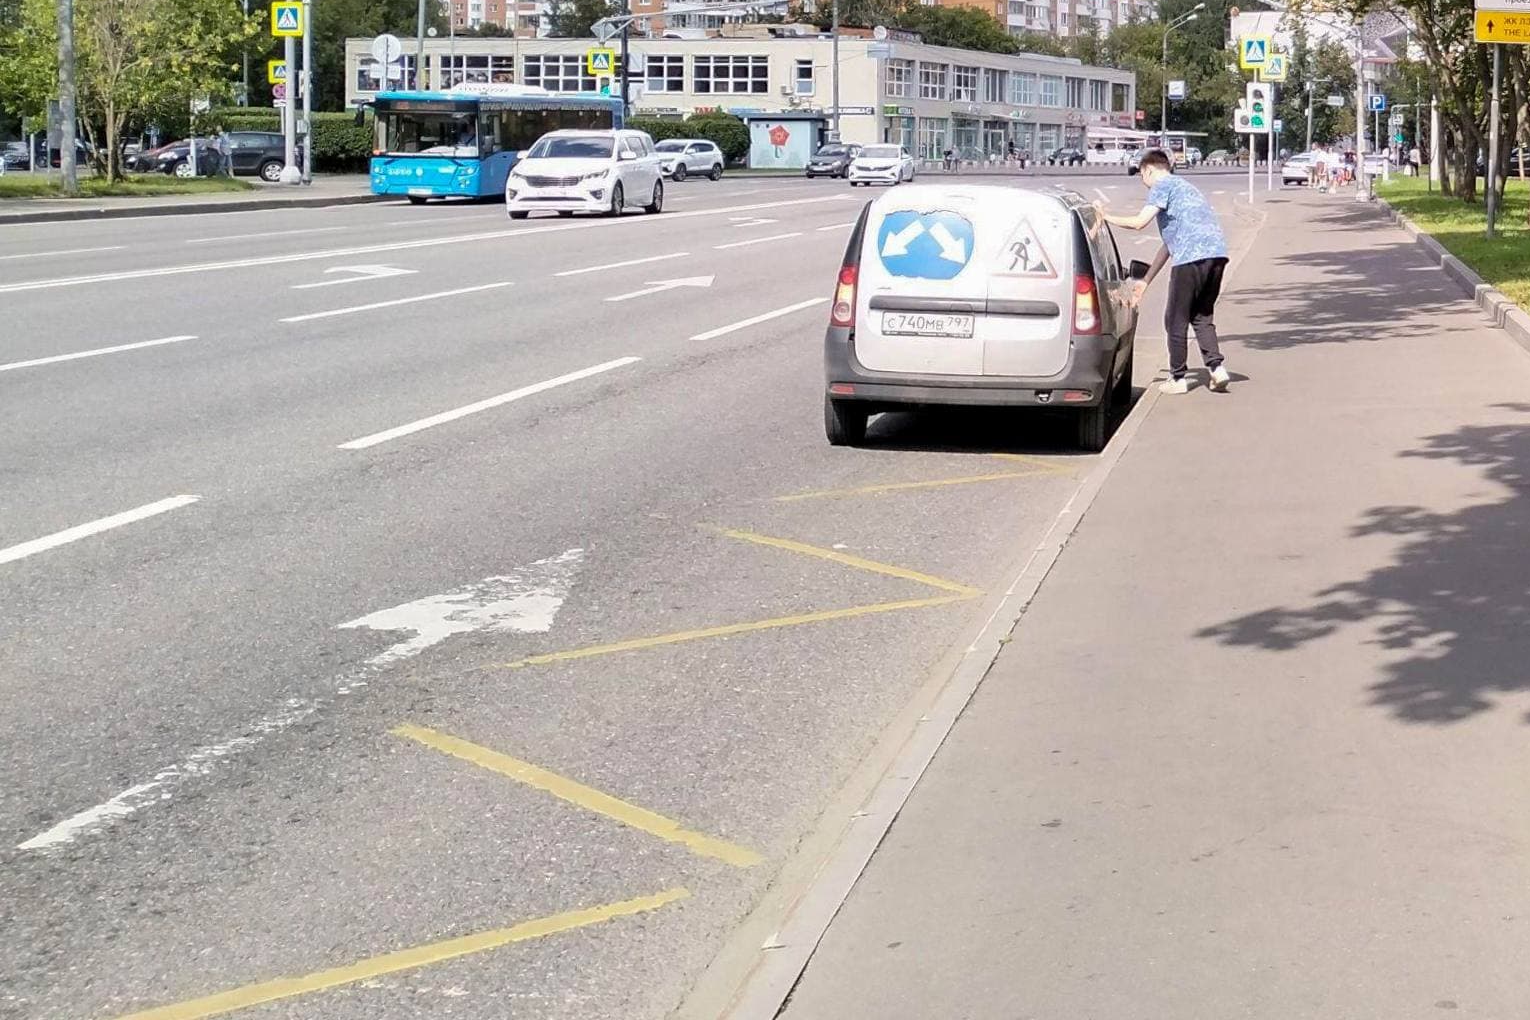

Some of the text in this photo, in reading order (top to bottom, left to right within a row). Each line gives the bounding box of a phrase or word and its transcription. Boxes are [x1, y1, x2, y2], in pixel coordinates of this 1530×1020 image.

[1503, 17, 1517, 26] ЖК
[1503, 29, 1521, 37] THE
[947, 316, 969, 326] 797
